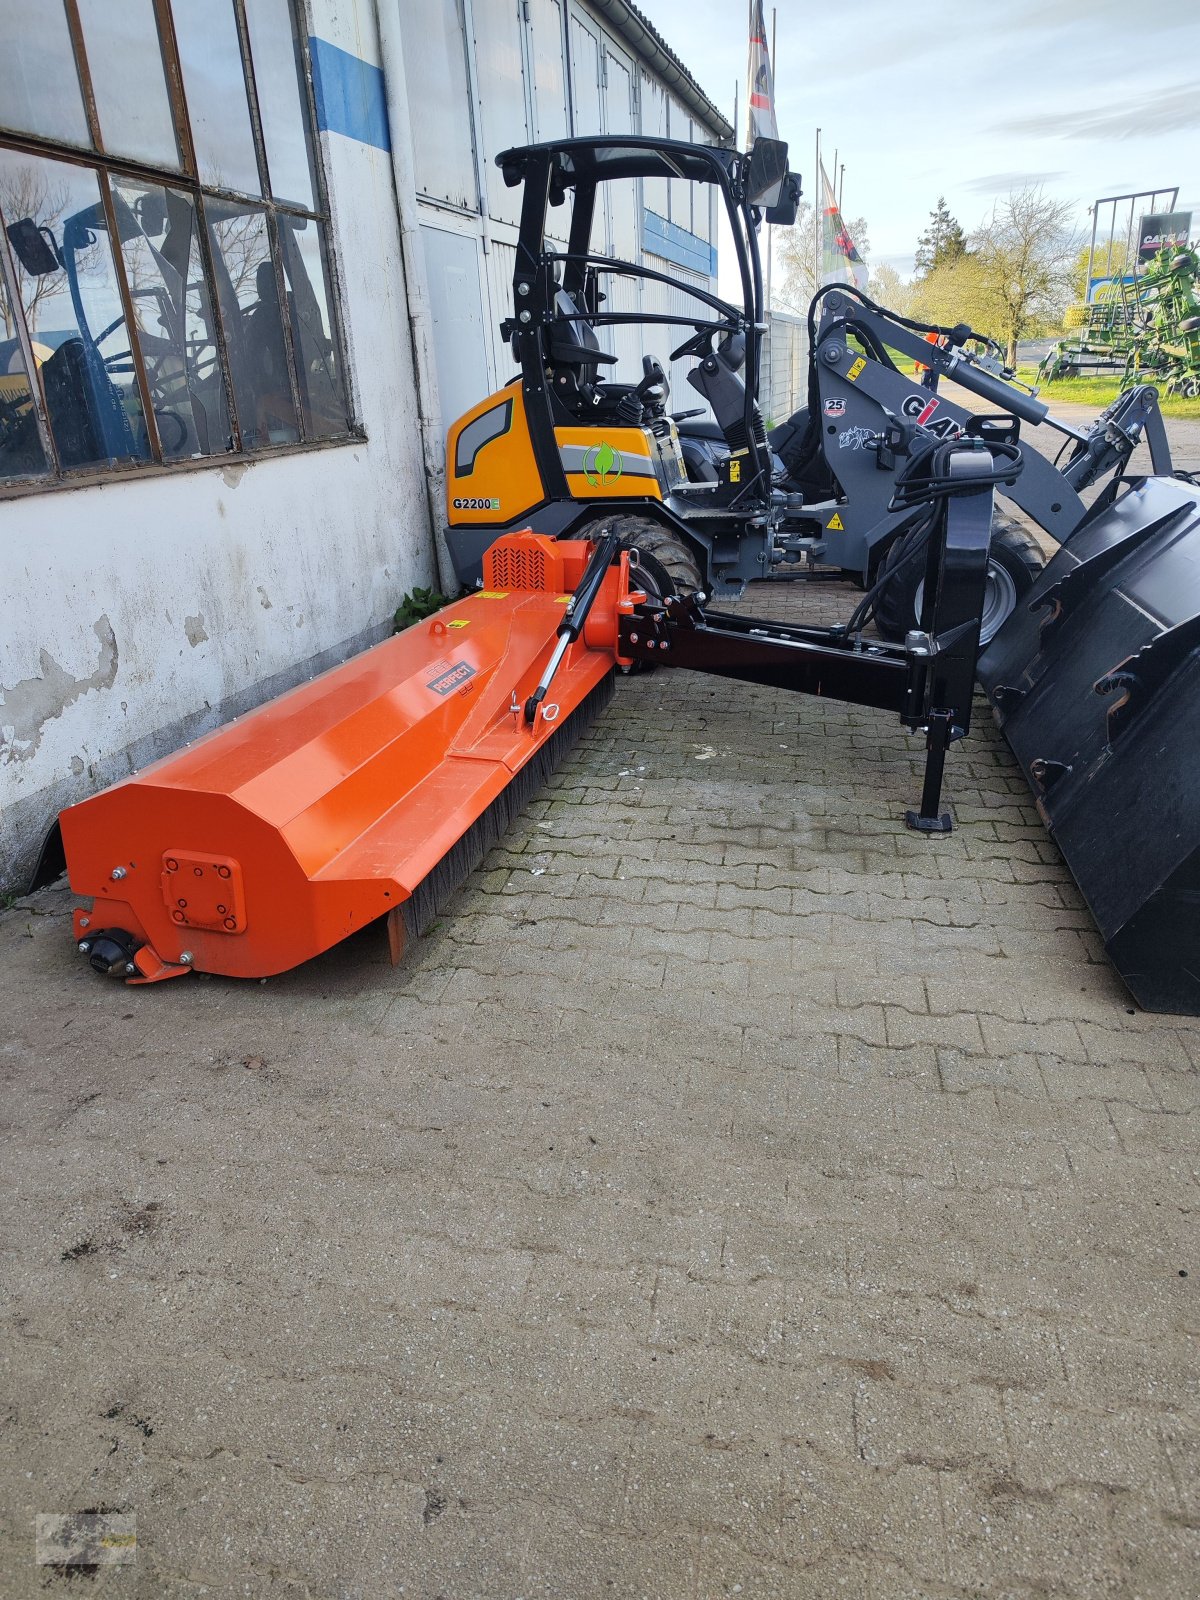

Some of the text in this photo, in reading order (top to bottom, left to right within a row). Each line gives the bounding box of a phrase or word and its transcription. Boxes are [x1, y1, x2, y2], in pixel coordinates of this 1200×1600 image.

[1143, 233, 1175, 244] CAS
[828, 400, 843, 410] 25
[452, 497, 500, 510] G2200E
[432, 664, 471, 693] PERFECT
